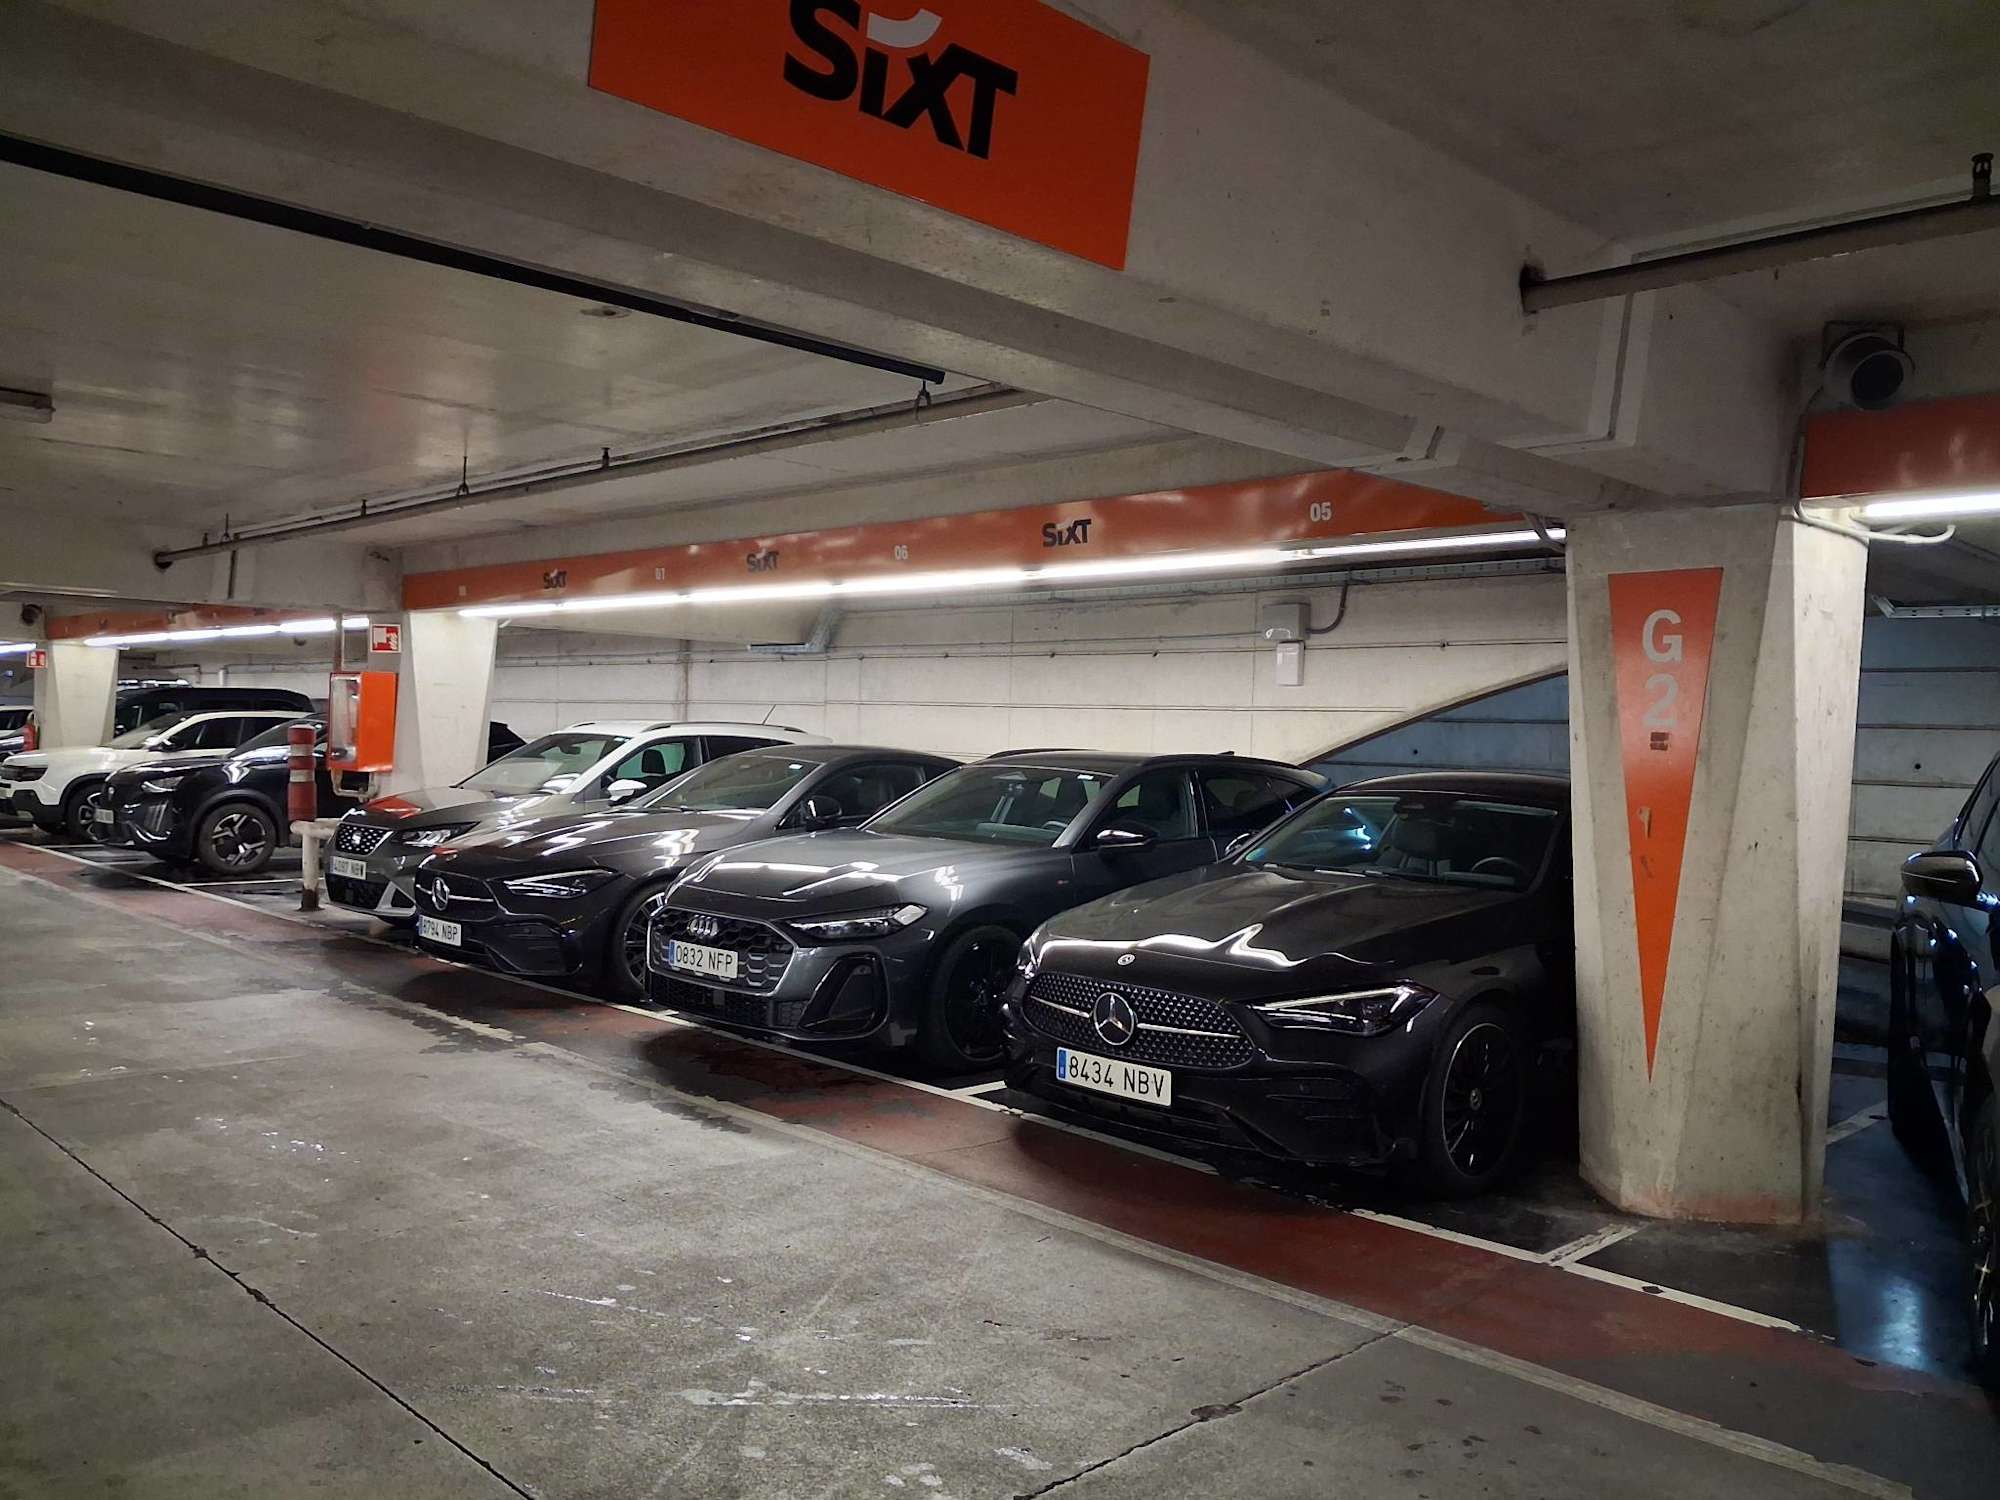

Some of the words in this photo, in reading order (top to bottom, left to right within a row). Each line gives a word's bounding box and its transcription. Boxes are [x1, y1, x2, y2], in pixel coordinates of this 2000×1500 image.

[1310, 502, 1332, 522] 05
[894, 545, 909, 561] 06
[1642, 609, 1683, 664] G
[1642, 673, 1680, 729] 2
[676, 945, 703, 967] 0832
[708, 951, 733, 973] NFP
[1069, 1056, 1114, 1088] 8434
[1124, 1067, 1164, 1098] NBV
